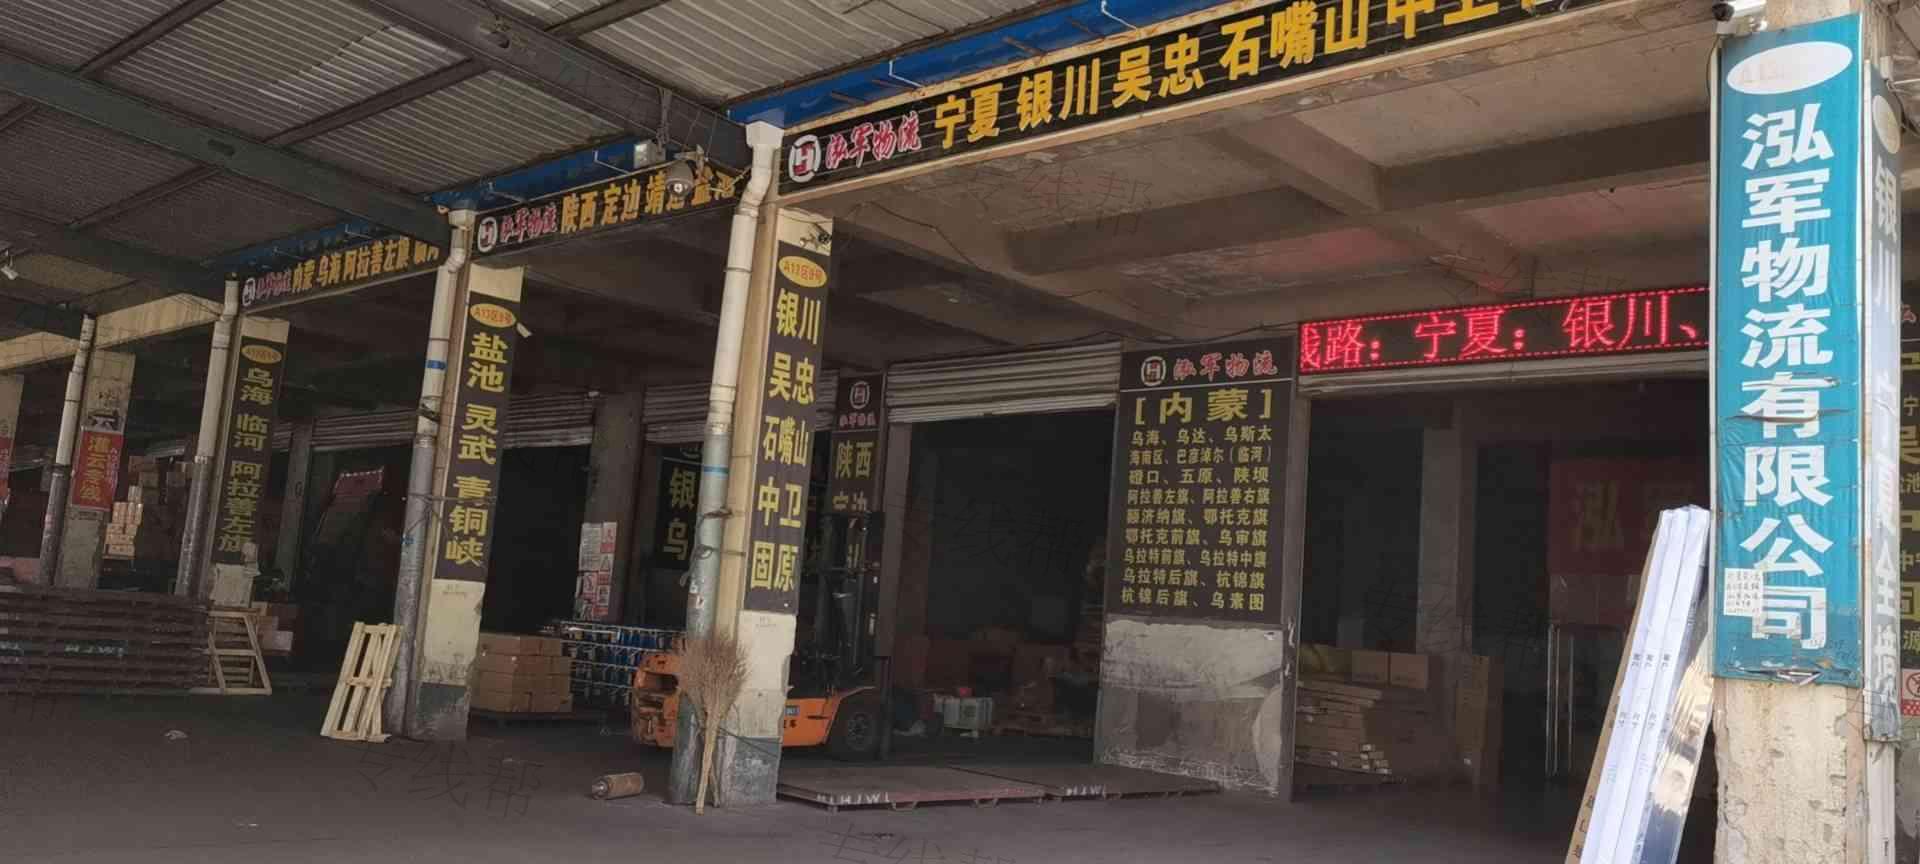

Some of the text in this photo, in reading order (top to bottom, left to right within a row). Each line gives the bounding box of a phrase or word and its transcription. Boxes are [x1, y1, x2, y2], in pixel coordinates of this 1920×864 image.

[825, 110, 921, 169] 泓军物流
[933, 83, 1003, 149] 宁夏
[1017, 59, 1101, 131] 银川
[1112, 34, 1205, 108] 吴忠
[1219, 0, 1369, 80] 石嘴山
[560, 191, 597, 233] 陕西
[601, 178, 642, 225] 定边
[343, 237, 410, 281] 阿拉善左旗
[775, 288, 822, 345] 银川
[240, 367, 273, 405] 乌海
[467, 332, 508, 393] 盐池
[768, 352, 815, 405] 吴忠
[1173, 350, 1278, 381] 泓军物流
[1739, 103, 1835, 649] 泓军物流有限公司
[233, 413, 270, 452] 临河
[458, 403, 499, 465] 灵武
[763, 415, 810, 468] 石嘴山
[835, 440, 874, 480] 陕西
[445, 475, 492, 567] 青铜峡
[757, 476, 803, 530] 中卫
[750, 540, 798, 593] 固原
